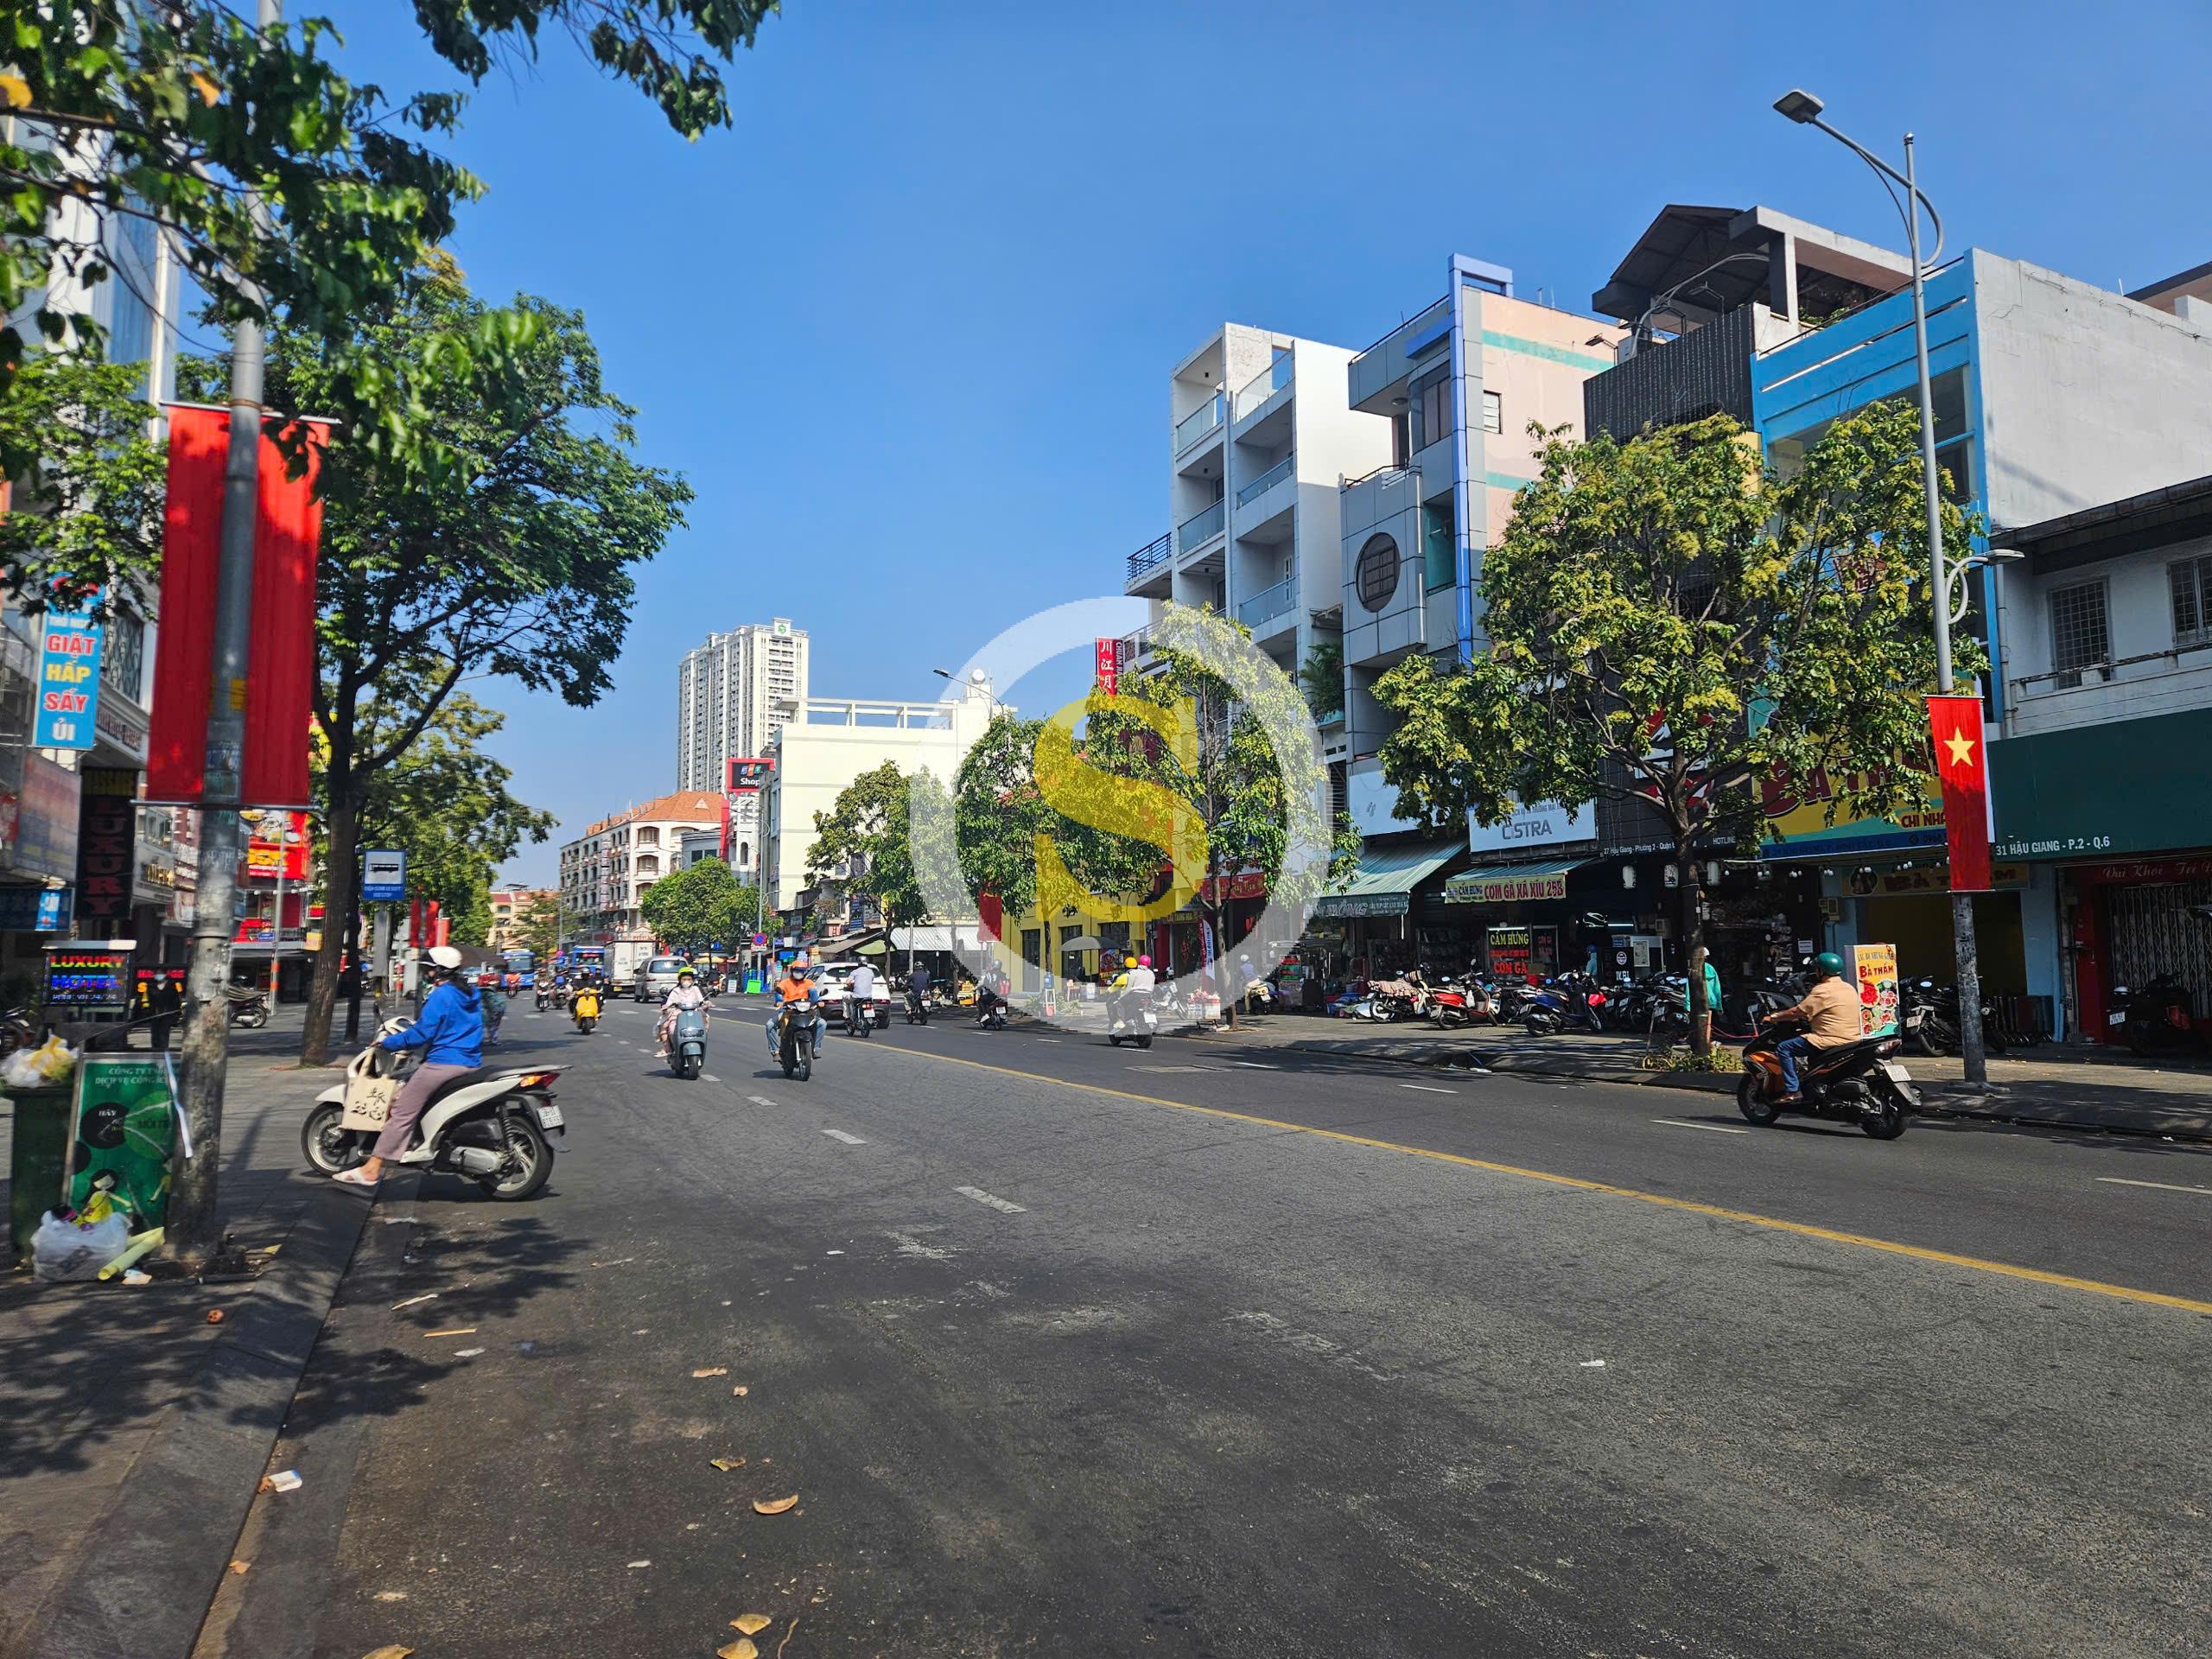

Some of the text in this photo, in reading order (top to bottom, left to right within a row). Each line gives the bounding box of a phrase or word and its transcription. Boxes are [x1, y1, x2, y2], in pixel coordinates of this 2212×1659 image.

[47, 632, 95, 658] GIẶT
[46, 658, 91, 683] HẤP
[44, 688, 88, 713] SẤY
[53, 717, 76, 741] ỦI
[741, 778, 760, 786] Shop
[1901, 815, 1920, 828] CHI
[1996, 845, 2007, 855] 31
[2010, 841, 2029, 856] HẬU
[2031, 841, 2060, 853] GIANG
[2069, 838, 2084, 850] P.2
[2094, 836, 2110, 849] Q.6
[50, 955, 125, 968] LUXURY
[51, 975, 119, 989] HOTEL
